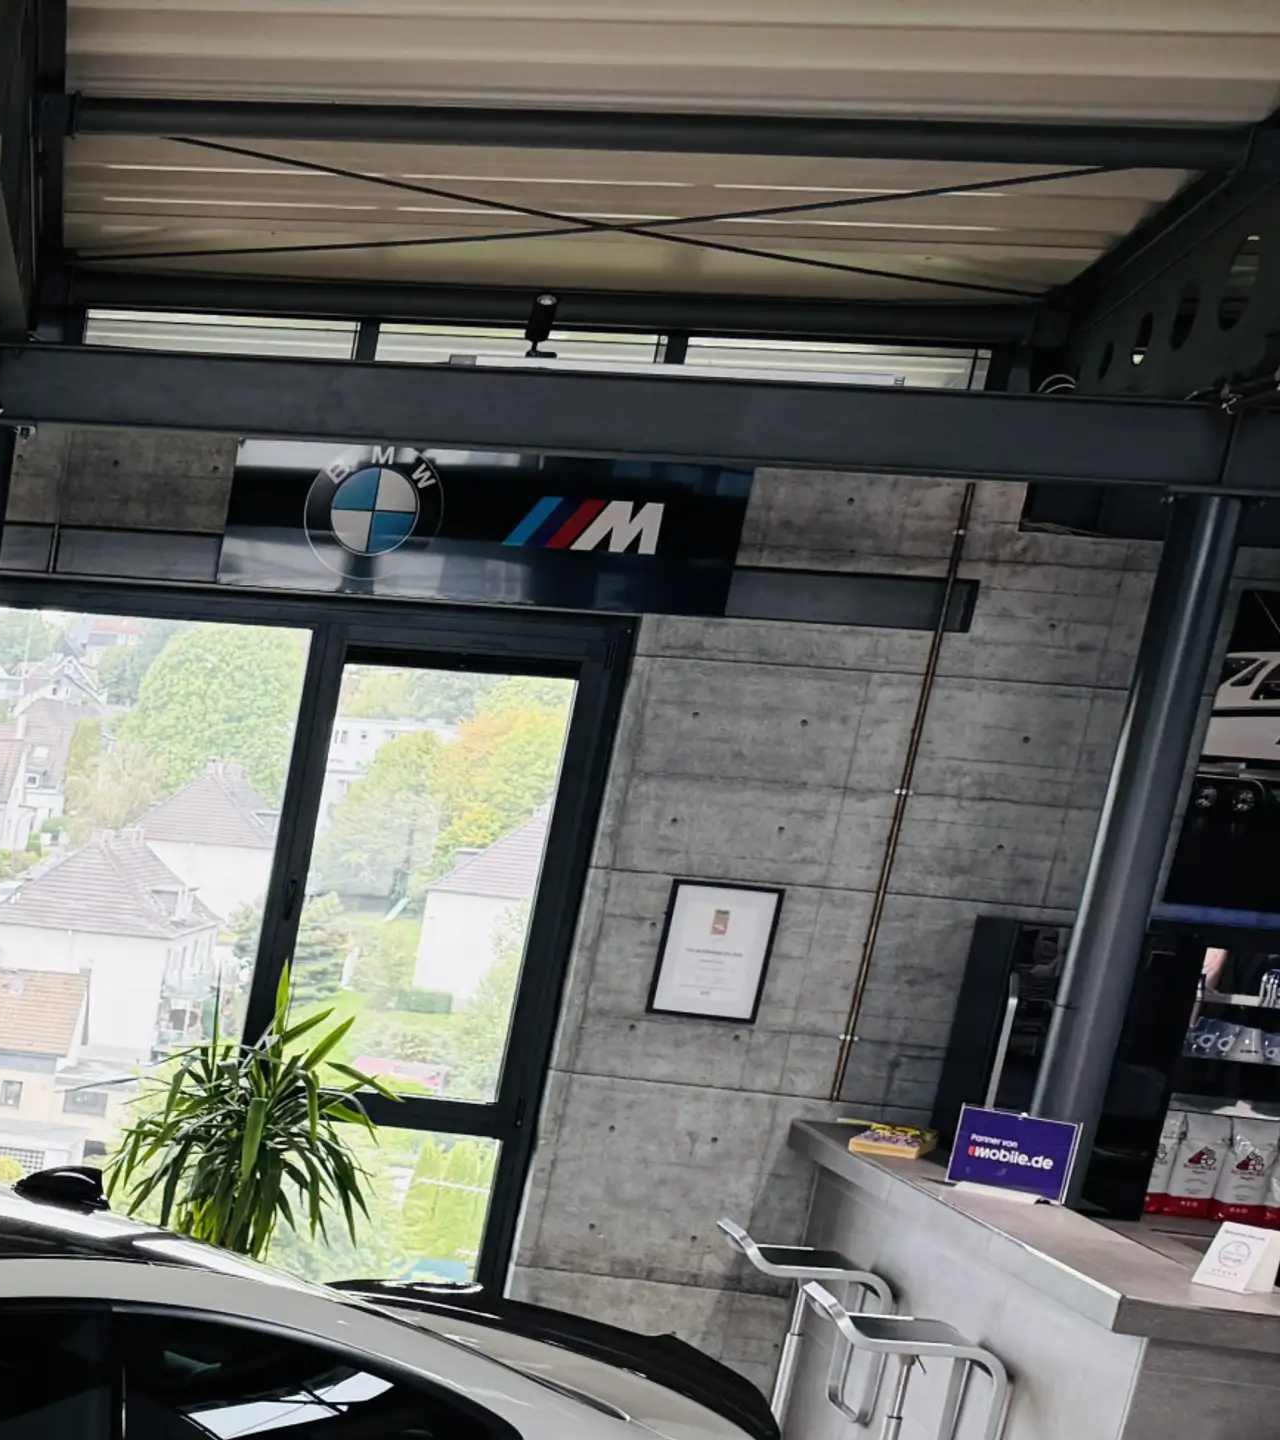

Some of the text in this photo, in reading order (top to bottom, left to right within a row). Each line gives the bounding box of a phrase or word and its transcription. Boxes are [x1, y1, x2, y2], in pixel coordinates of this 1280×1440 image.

[325, 445, 437, 490] BMW
[1002, 1139, 1019, 1148] von
[968, 1145, 1054, 1170] mobile.de
